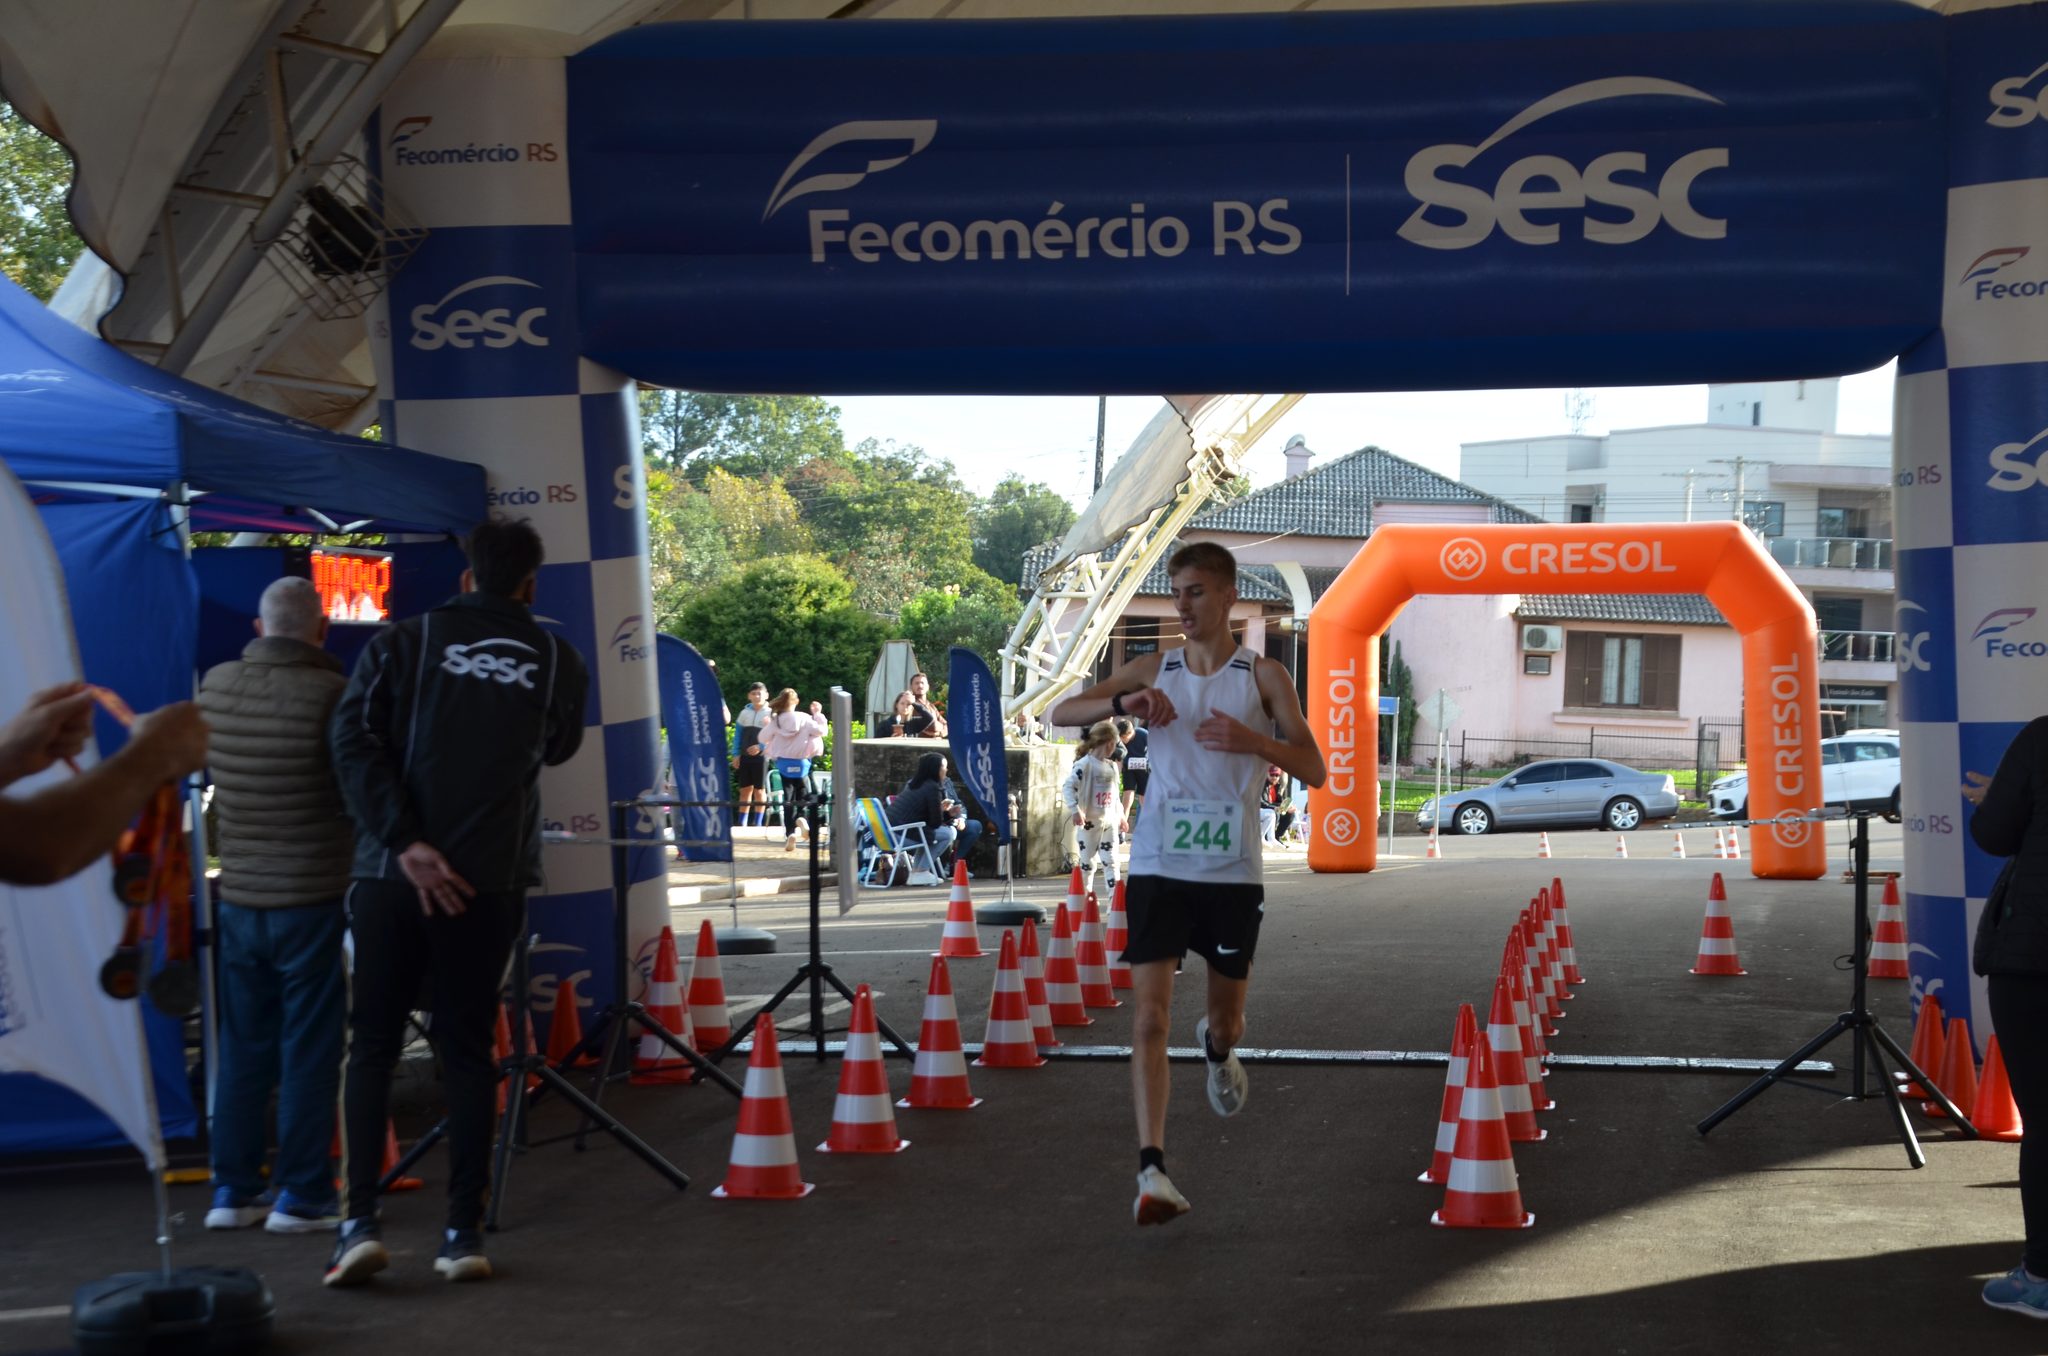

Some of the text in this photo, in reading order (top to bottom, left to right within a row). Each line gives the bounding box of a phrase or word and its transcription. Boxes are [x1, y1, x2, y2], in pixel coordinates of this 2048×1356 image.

[396, 142, 559, 166] Fecomércio RS
[808, 197, 1302, 263] Fecomércio RS
[1917, 463, 1942, 485] RS
[547, 484, 578, 504] RS
[1501, 540, 1677, 575] CRESOL
[1328, 657, 1356, 797] CRESOL
[1770, 652, 1803, 797] CRESOL
[571, 813, 601, 832] RS
[1173, 819, 1232, 851] 244
[1928, 813, 1954, 834] RS
